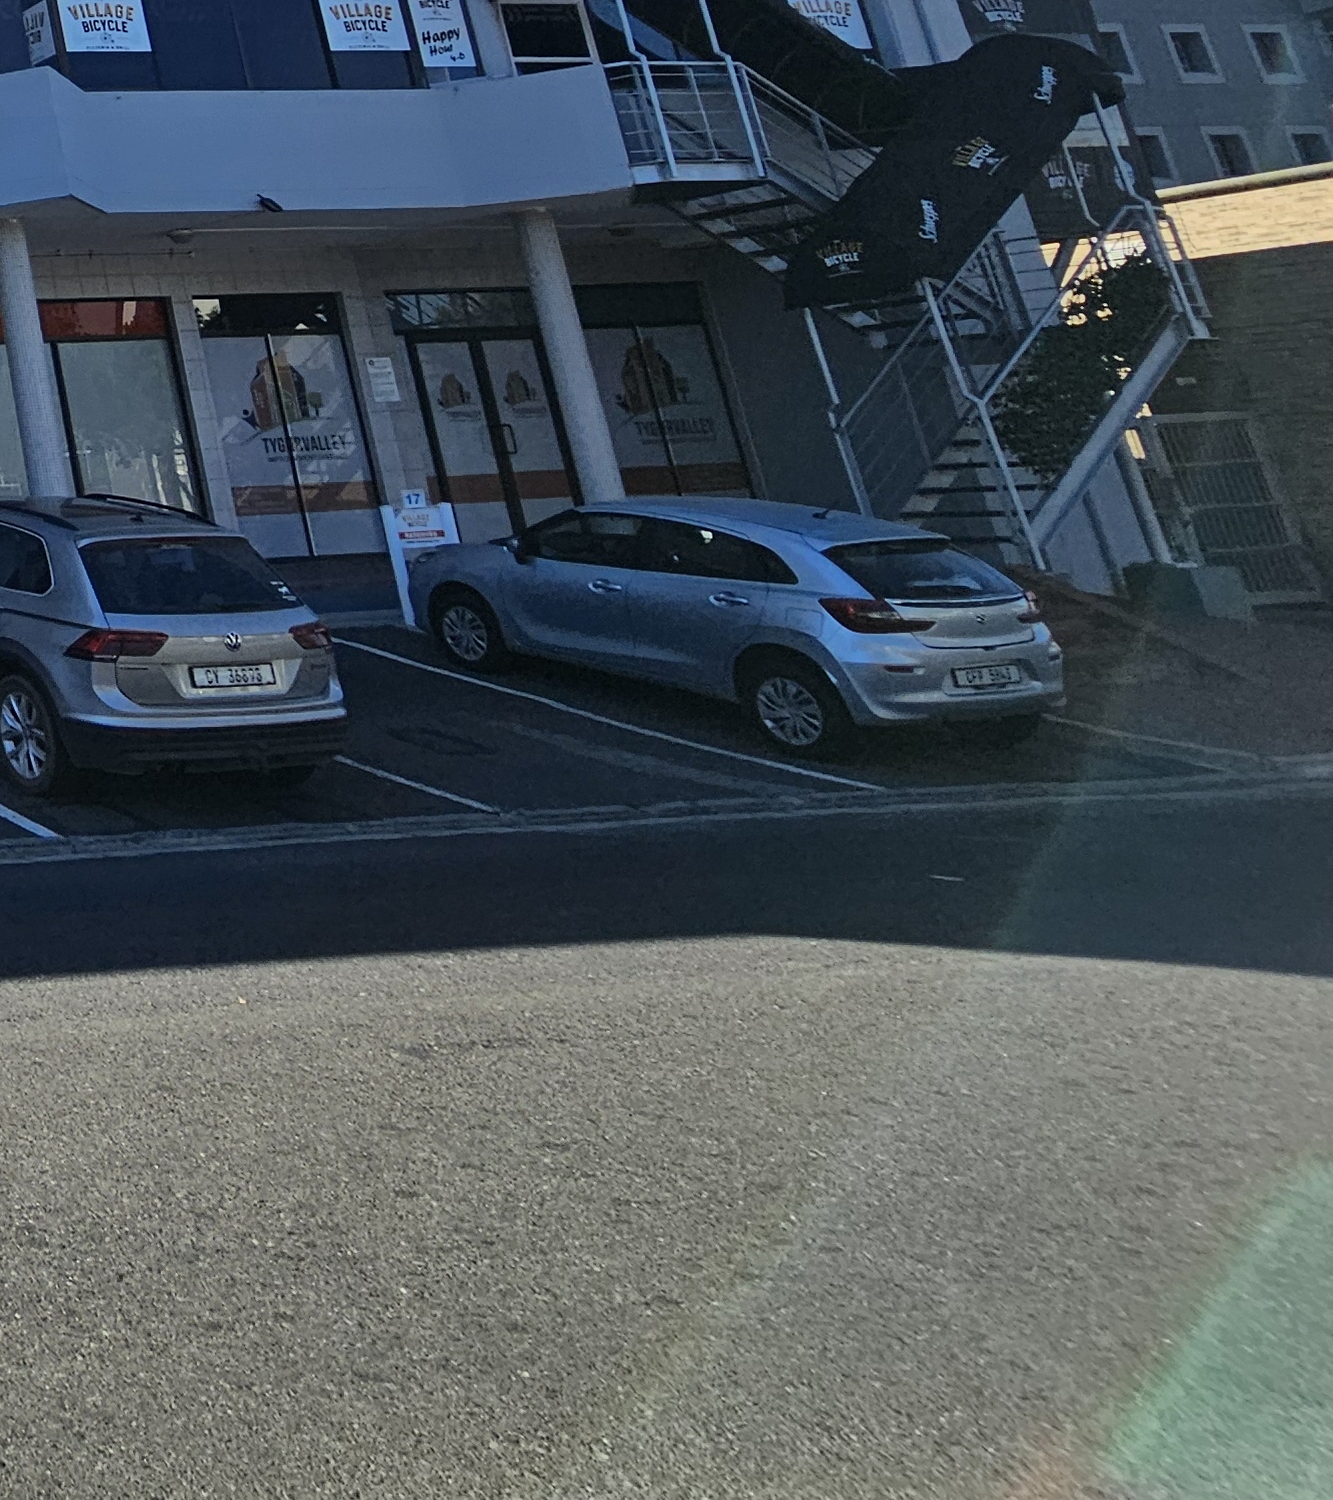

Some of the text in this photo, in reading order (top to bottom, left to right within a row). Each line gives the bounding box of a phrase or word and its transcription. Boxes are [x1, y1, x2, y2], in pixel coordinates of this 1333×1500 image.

[67, 2, 134, 22] VILLAGE
[329, 2, 393, 21] VILLAGE
[81, 19, 129, 33] BICYCLE
[343, 19, 388, 33] BICYCLE
[422, 27, 460, 45] Happy
[429, 44, 453, 57] Hour
[262, 434, 349, 454] TYGRVALLEY
[405, 493, 420, 505] 17
